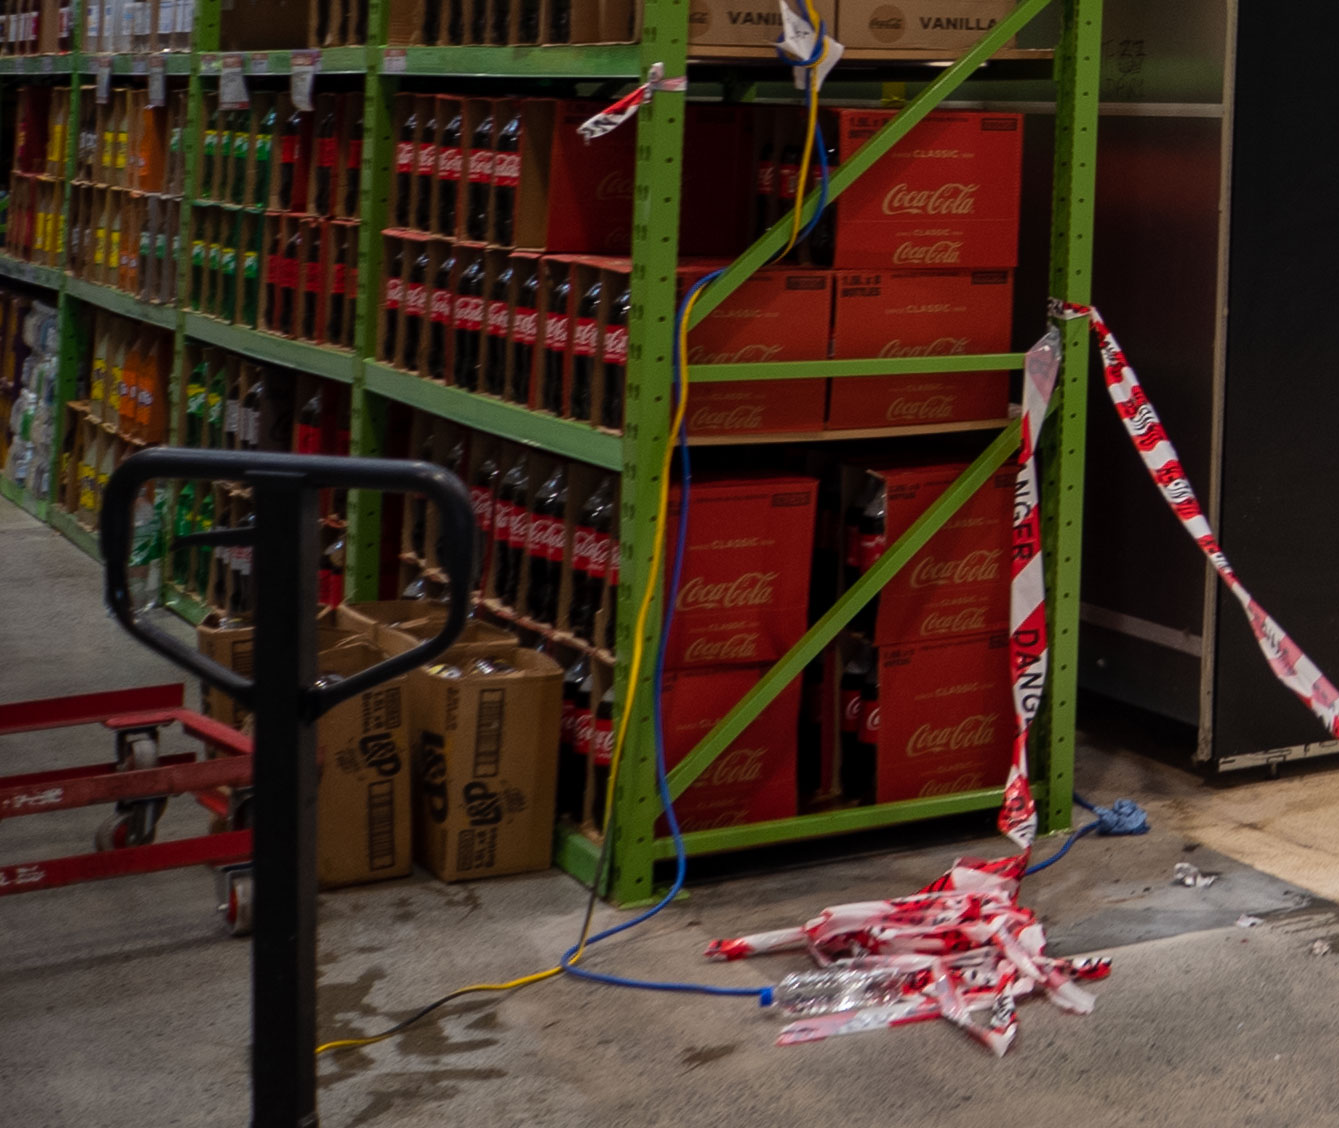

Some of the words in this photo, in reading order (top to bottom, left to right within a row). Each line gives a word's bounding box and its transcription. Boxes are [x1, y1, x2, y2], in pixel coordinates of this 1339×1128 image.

[912, 149, 959, 159] CLASSIC
[882, 183, 981, 216] Coca-Cola
[892, 240, 965, 264] Coca-Cola
[905, 303, 952, 314] CLASSIC
[690, 405, 766, 430] Coca-Cola
[886, 396, 955, 421] Coca-Cola
[1011, 460, 1034, 562] ANGER
[909, 549, 1003, 590] Coca-Cola
[677, 571, 782, 612] Coca-Cola
[919, 607, 990, 637] Coca-Cola
[685, 632, 764, 662] Coca-Cola
[905, 713, 1000, 758] Coca-Cola
[358, 733, 403, 778] L&P
[462, 781, 502, 827] L&P
